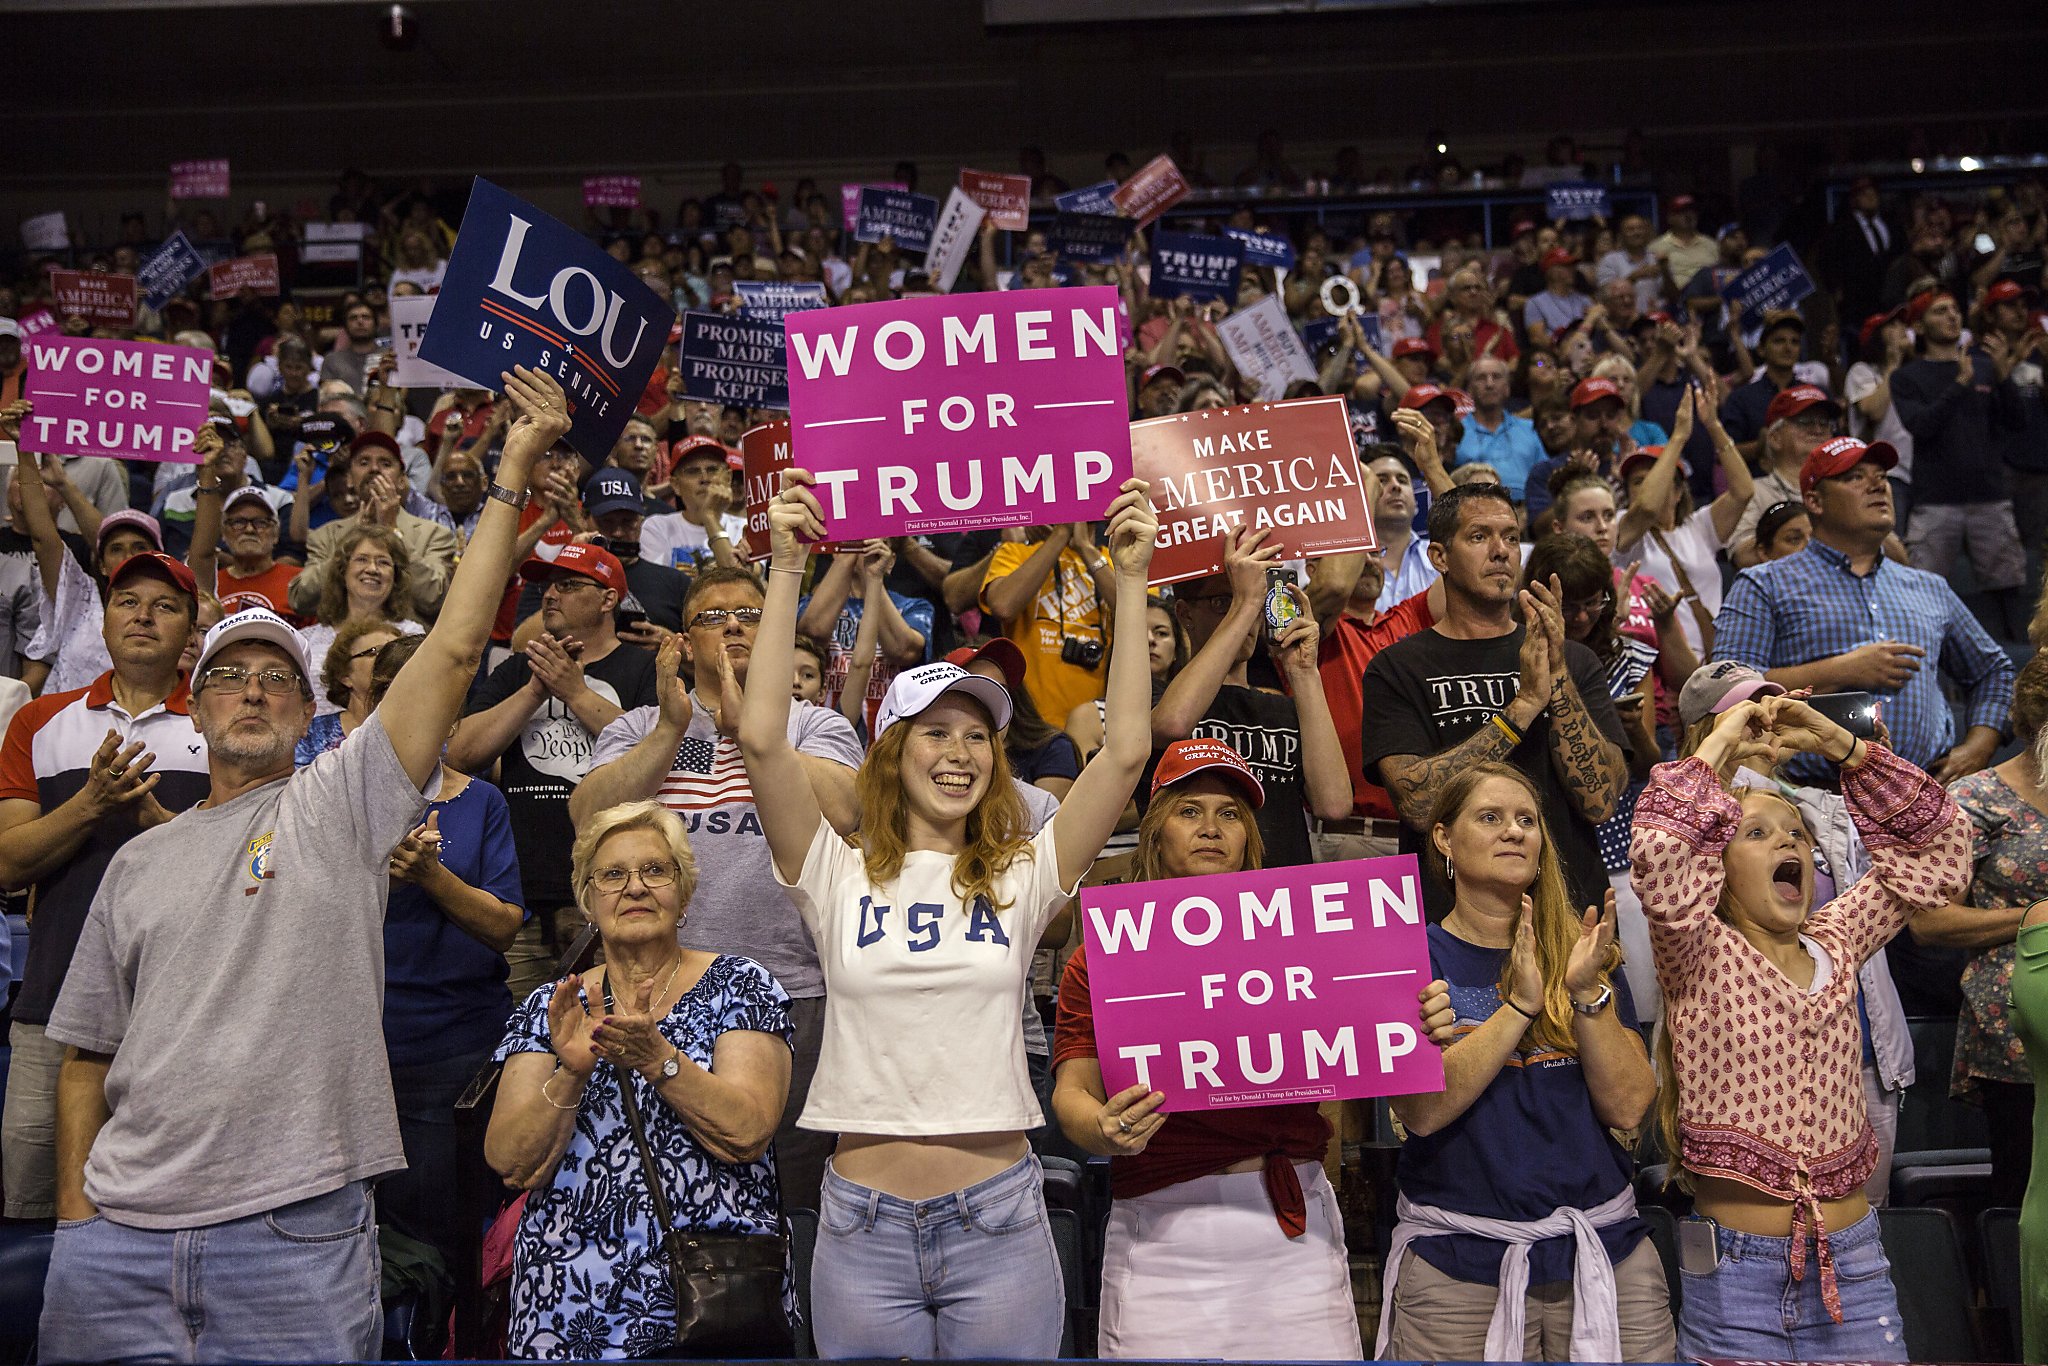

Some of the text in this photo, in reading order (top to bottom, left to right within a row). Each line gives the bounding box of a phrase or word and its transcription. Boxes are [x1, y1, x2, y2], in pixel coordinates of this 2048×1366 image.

[1158, 249, 1238, 271] TRUMP
[1163, 264, 1230, 281] PENCE
[57, 288, 133, 309] AMERICA
[488, 213, 649, 369] LOU
[1320, 274, 1366, 317] Q
[696, 322, 786, 349] PROMISE
[790, 307, 1118, 381] WOMEN
[1277, 330, 1298, 357] BUY
[33, 344, 211, 384] WOMEN
[716, 342, 775, 365] MADE
[539, 350, 609, 418] SENATE
[713, 381, 768, 402] KEPT
[85, 387, 148, 411] FOR
[902, 393, 1018, 435] FOR
[32, 416, 195, 453] TRUMP
[1193, 429, 1272, 459] MAKE
[600, 481, 633, 497] USA
[814, 450, 1114, 520] TRUMP
[939, 518, 958, 527] Donald
[963, 516, 982, 527] Trump
[1154, 498, 1347, 550] GREAT AGAIN
[1275, 579, 1284, 628] GREENHOUSE
[218, 614, 249, 632] MAKE
[1039, 627, 1057, 637] You
[911, 667, 945, 681] MAKE
[919, 672, 957, 685] GREAT
[528, 730, 594, 765] Peopl
[1178, 744, 1209, 754] MAKE
[1184, 752, 1219, 761] GREAT
[856, 894, 1010, 952] USA
[1087, 875, 1420, 955] WOMEN
[1201, 966, 1317, 1010] FOR
[1118, 1022, 1418, 1093] TRUMP
[1543, 1058, 1566, 1069] United
[1211, 1095, 1224, 1103] Paid
[1233, 1095, 1241, 1103] by
[1241, 1093, 1262, 1101] Donald
[1266, 1091, 1285, 1100] Trump
